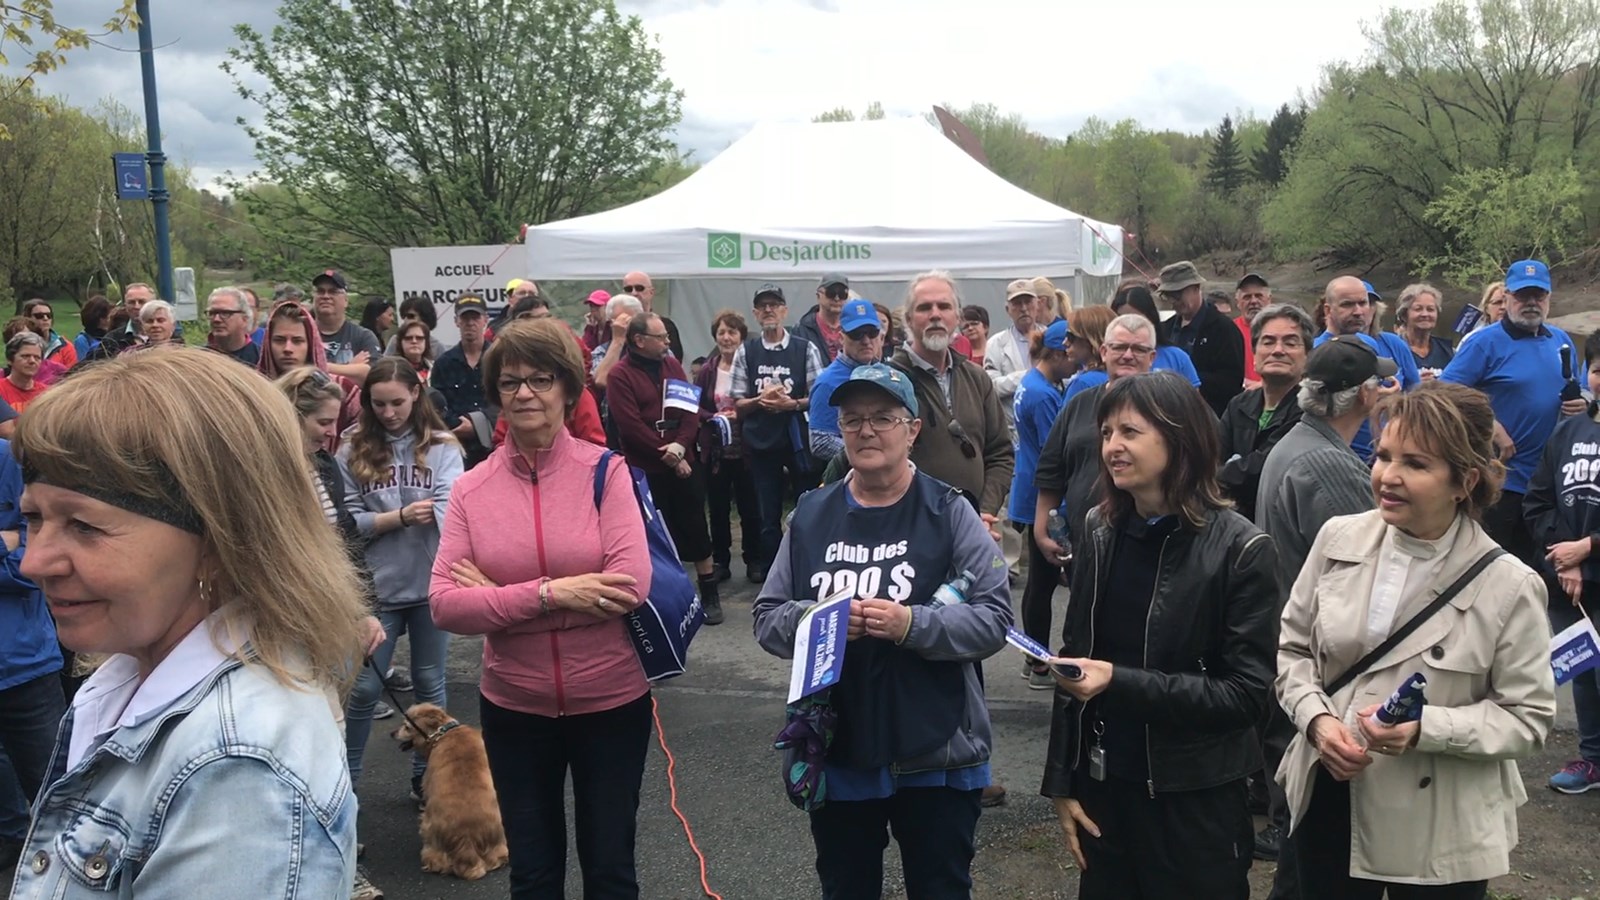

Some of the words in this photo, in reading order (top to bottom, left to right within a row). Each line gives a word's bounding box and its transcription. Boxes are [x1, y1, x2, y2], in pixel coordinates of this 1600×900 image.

[749, 239, 872, 267] Desjardins
[434, 264, 495, 277] ACCUEIL
[824, 541, 870, 564] Club
[872, 539, 909, 562] des
[810, 565, 882, 603] 200
[887, 561, 916, 604] $
[825, 609, 840, 656] MARCHONS
